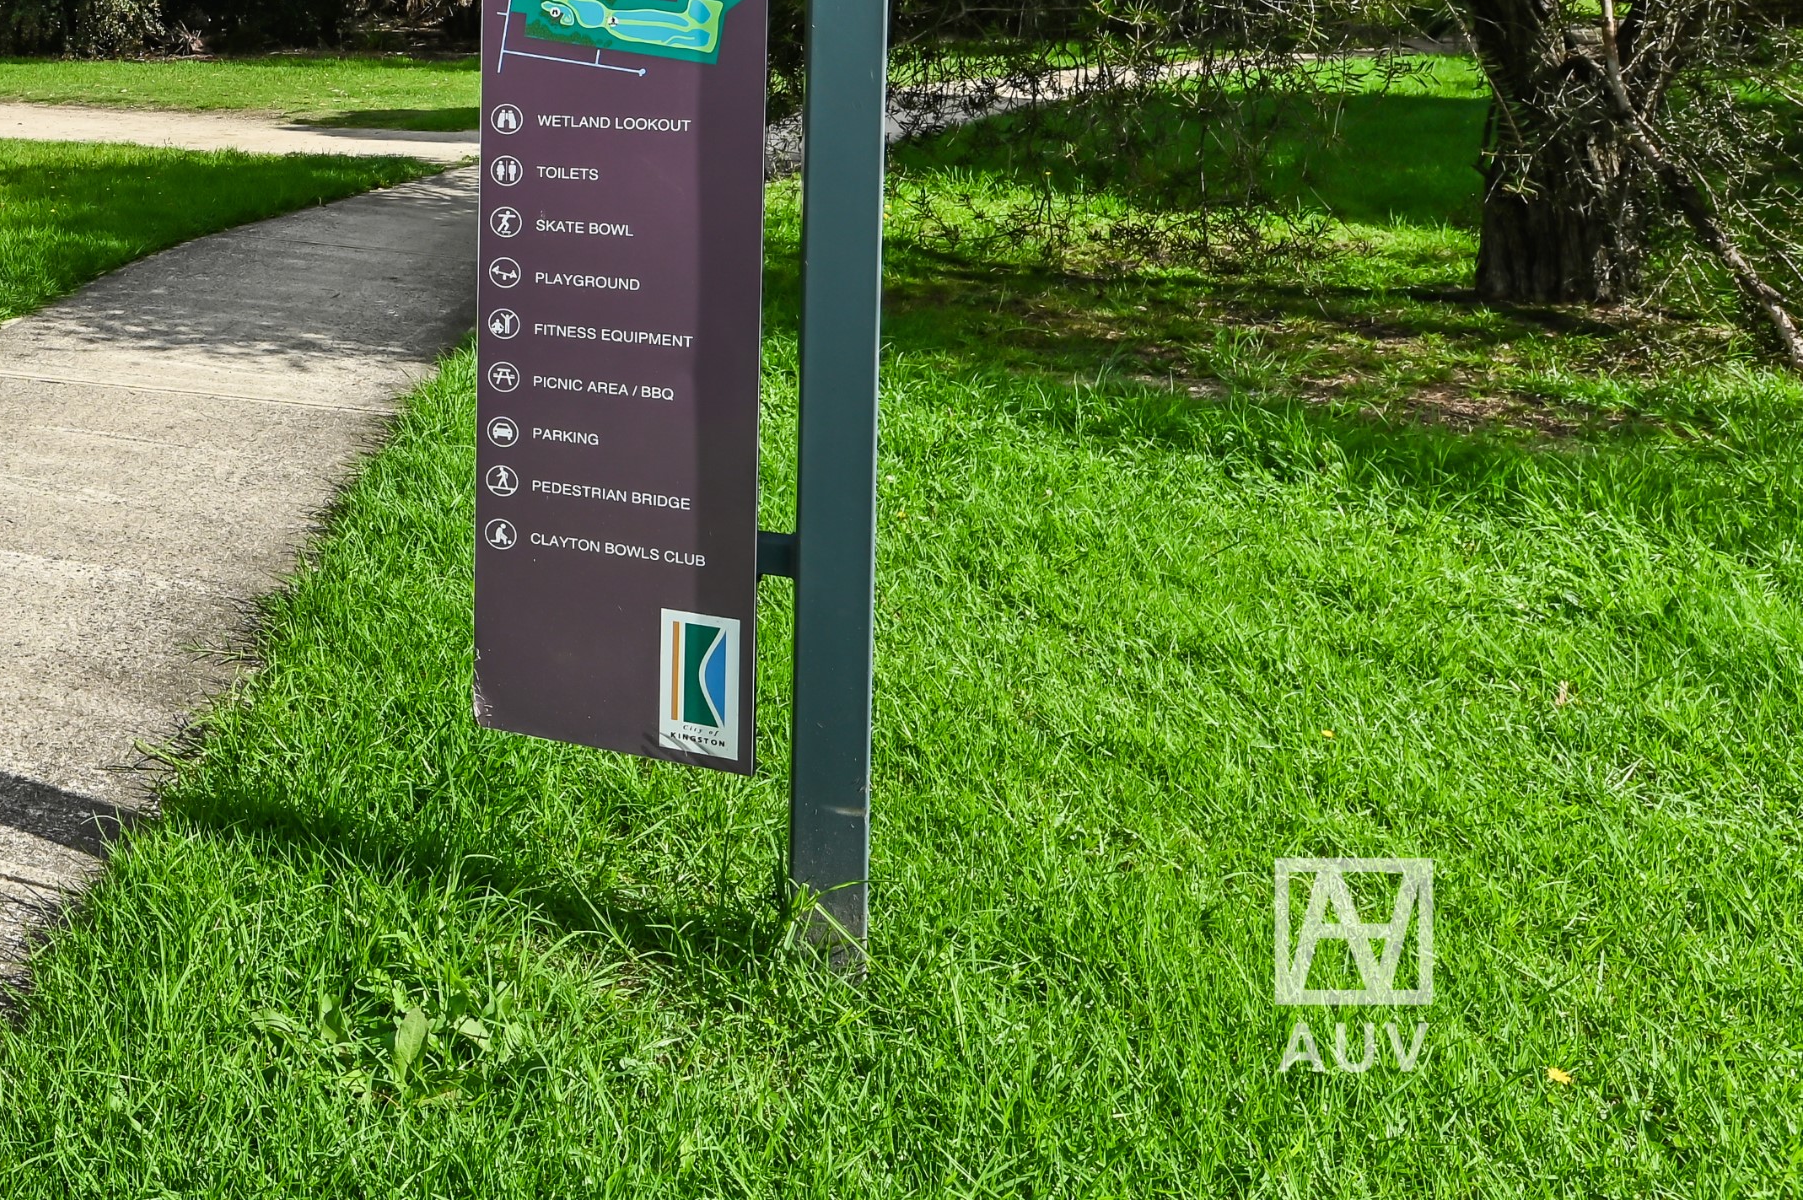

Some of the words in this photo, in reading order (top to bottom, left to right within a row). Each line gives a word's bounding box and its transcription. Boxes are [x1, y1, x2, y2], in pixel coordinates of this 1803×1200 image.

[538, 114, 611, 129] WETLAND
[615, 117, 691, 132] LOOKOUT
[536, 166, 599, 180] TOILETS
[535, 219, 584, 234] SKATE
[589, 223, 634, 237] BOWL
[535, 272, 640, 291] PLAYGROUND
[534, 323, 596, 340] FITNESS
[601, 329, 693, 348] EQUIPMENT
[533, 376, 583, 391] PICNIC
[587, 381, 628, 396] AREA
[632, 386, 637, 396] /
[641, 386, 674, 401] BBQ
[533, 427, 599, 445] PARKING
[532, 480, 627, 502] PEDESTRIAN
[632, 492, 691, 510] BRIDGE
[530, 532, 600, 552] CLAYTON
[605, 542, 659, 561] BOWLS
[664, 551, 706, 567] CLUB
[683, 724, 703, 734] City
[670, 732, 725, 747] KINGSTON
